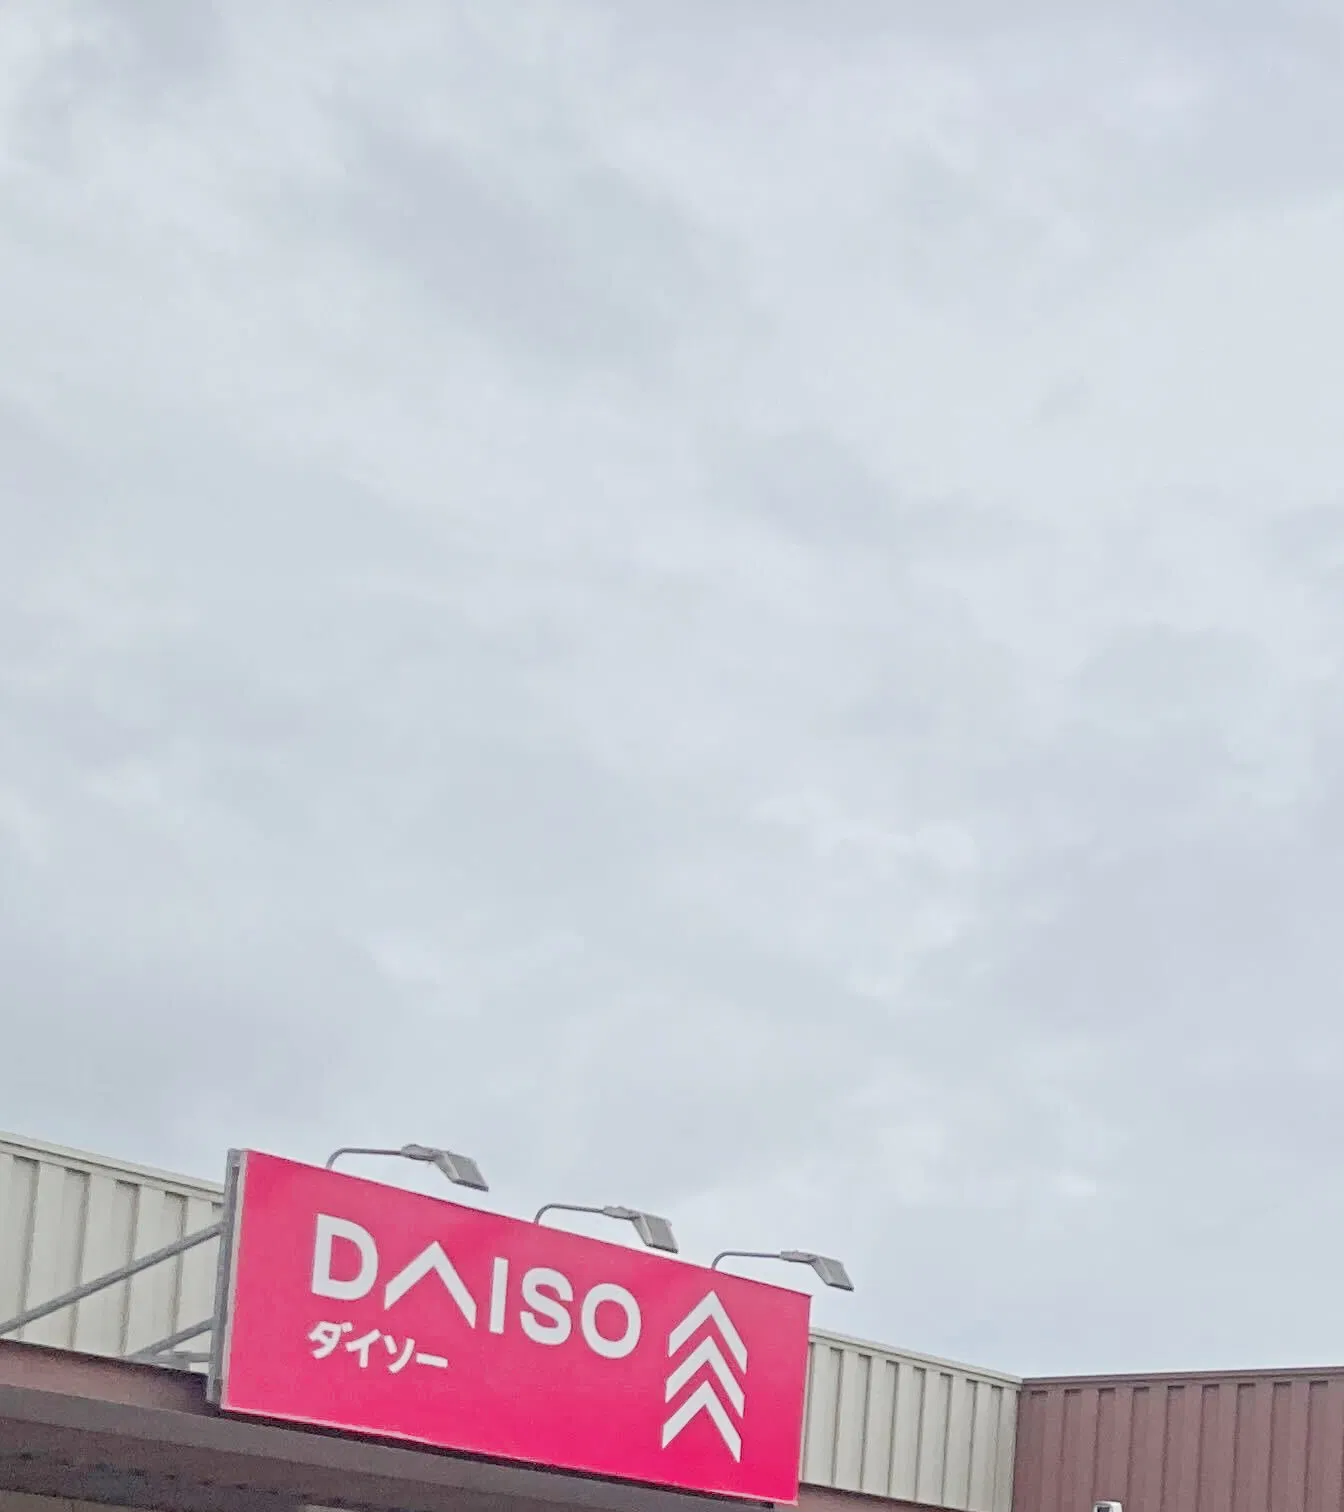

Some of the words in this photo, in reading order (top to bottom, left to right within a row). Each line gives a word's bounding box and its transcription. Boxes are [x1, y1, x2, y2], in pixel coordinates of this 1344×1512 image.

[311, 1212, 642, 1359] DAISO
[308, 1320, 449, 1374] ダイソー
